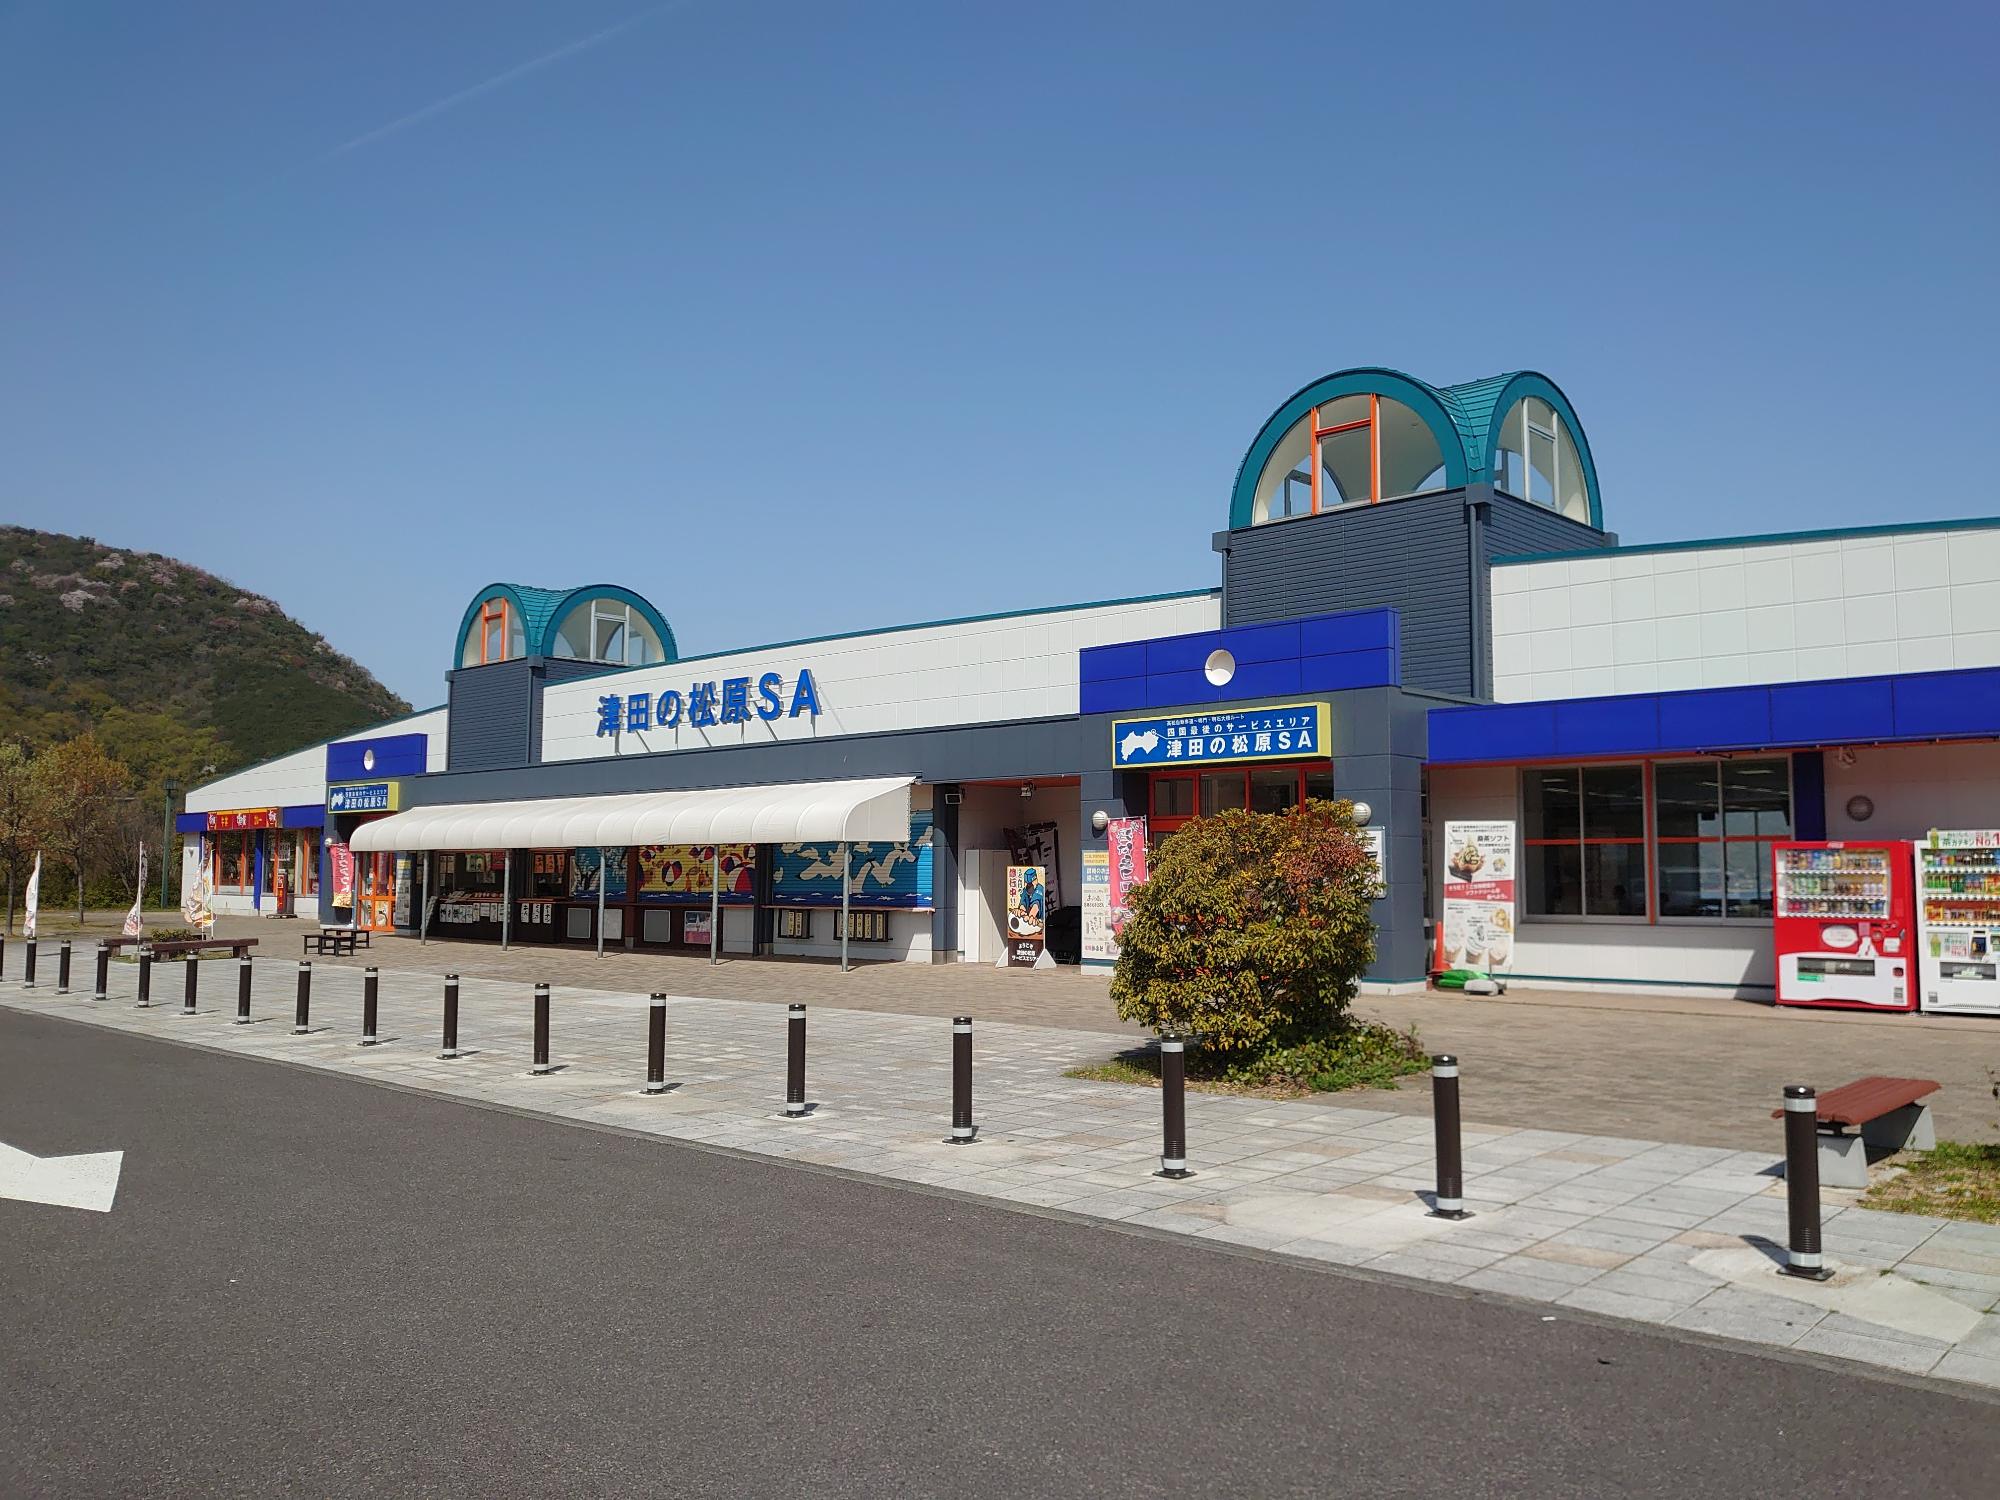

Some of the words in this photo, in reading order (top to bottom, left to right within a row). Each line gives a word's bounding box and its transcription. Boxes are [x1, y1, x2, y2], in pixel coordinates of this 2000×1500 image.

[596, 668, 823, 737] 津田の松原SA
[1167, 716, 1310, 737] 四国最後のサービスエリア
[1166, 731, 1313, 758] 津田の松原SA
